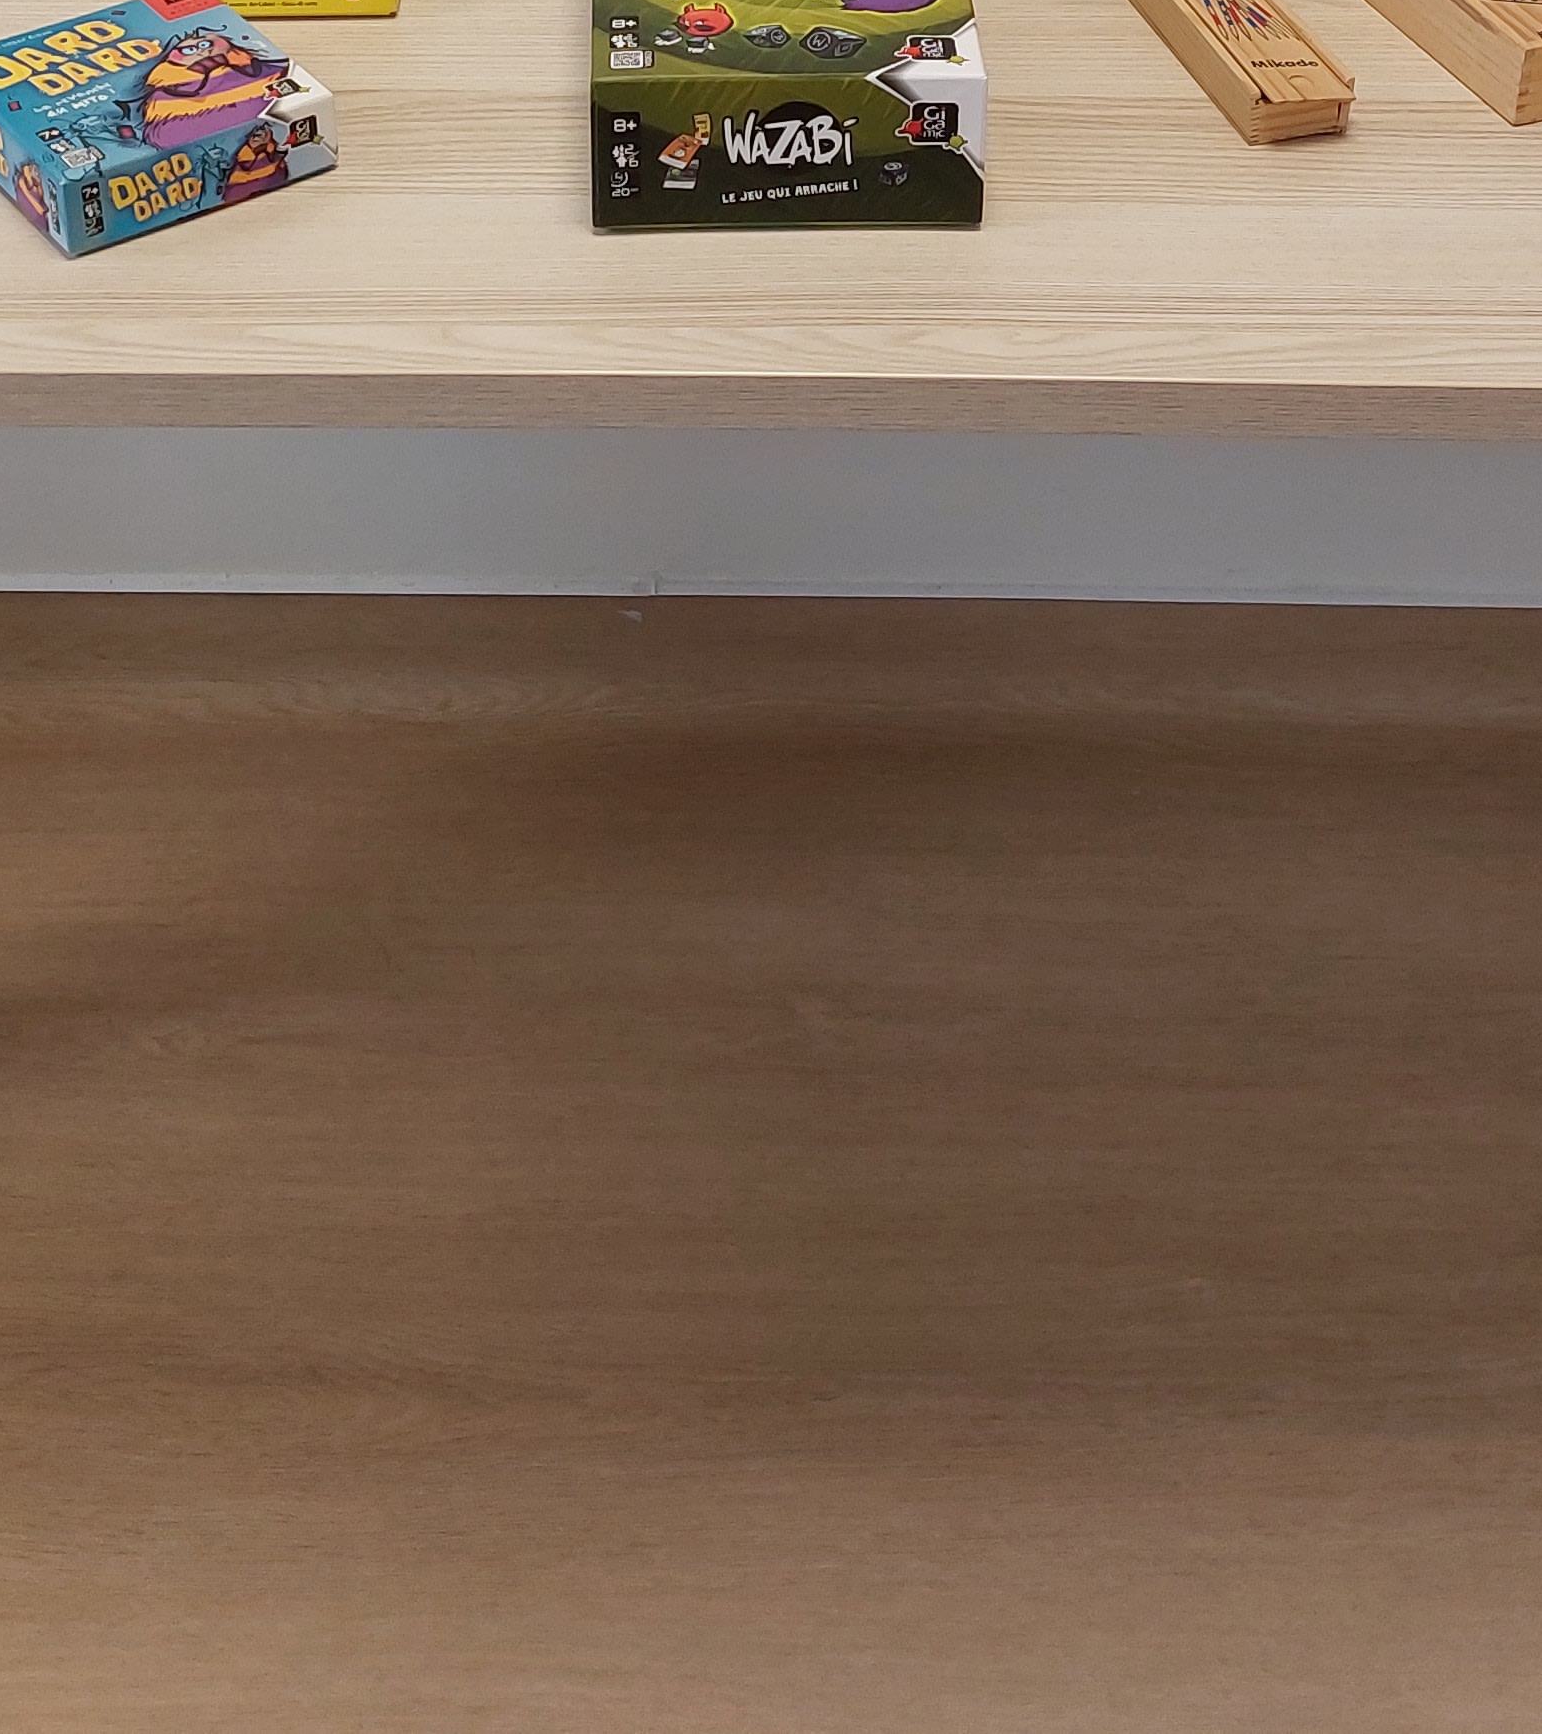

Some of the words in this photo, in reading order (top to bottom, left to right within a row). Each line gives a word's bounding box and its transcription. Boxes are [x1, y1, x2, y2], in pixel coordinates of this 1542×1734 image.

[28, 38, 164, 97] DARD
[1250, 59, 1320, 69] Mikado
[613, 118, 638, 133] 8+
[108, 152, 193, 211] DARD
[721, 191, 736, 205] LE
[738, 188, 764, 203] JEU
[766, 185, 793, 200] QUI
[794, 180, 851, 198] ARRACHE
[133, 177, 203, 223] DARD
